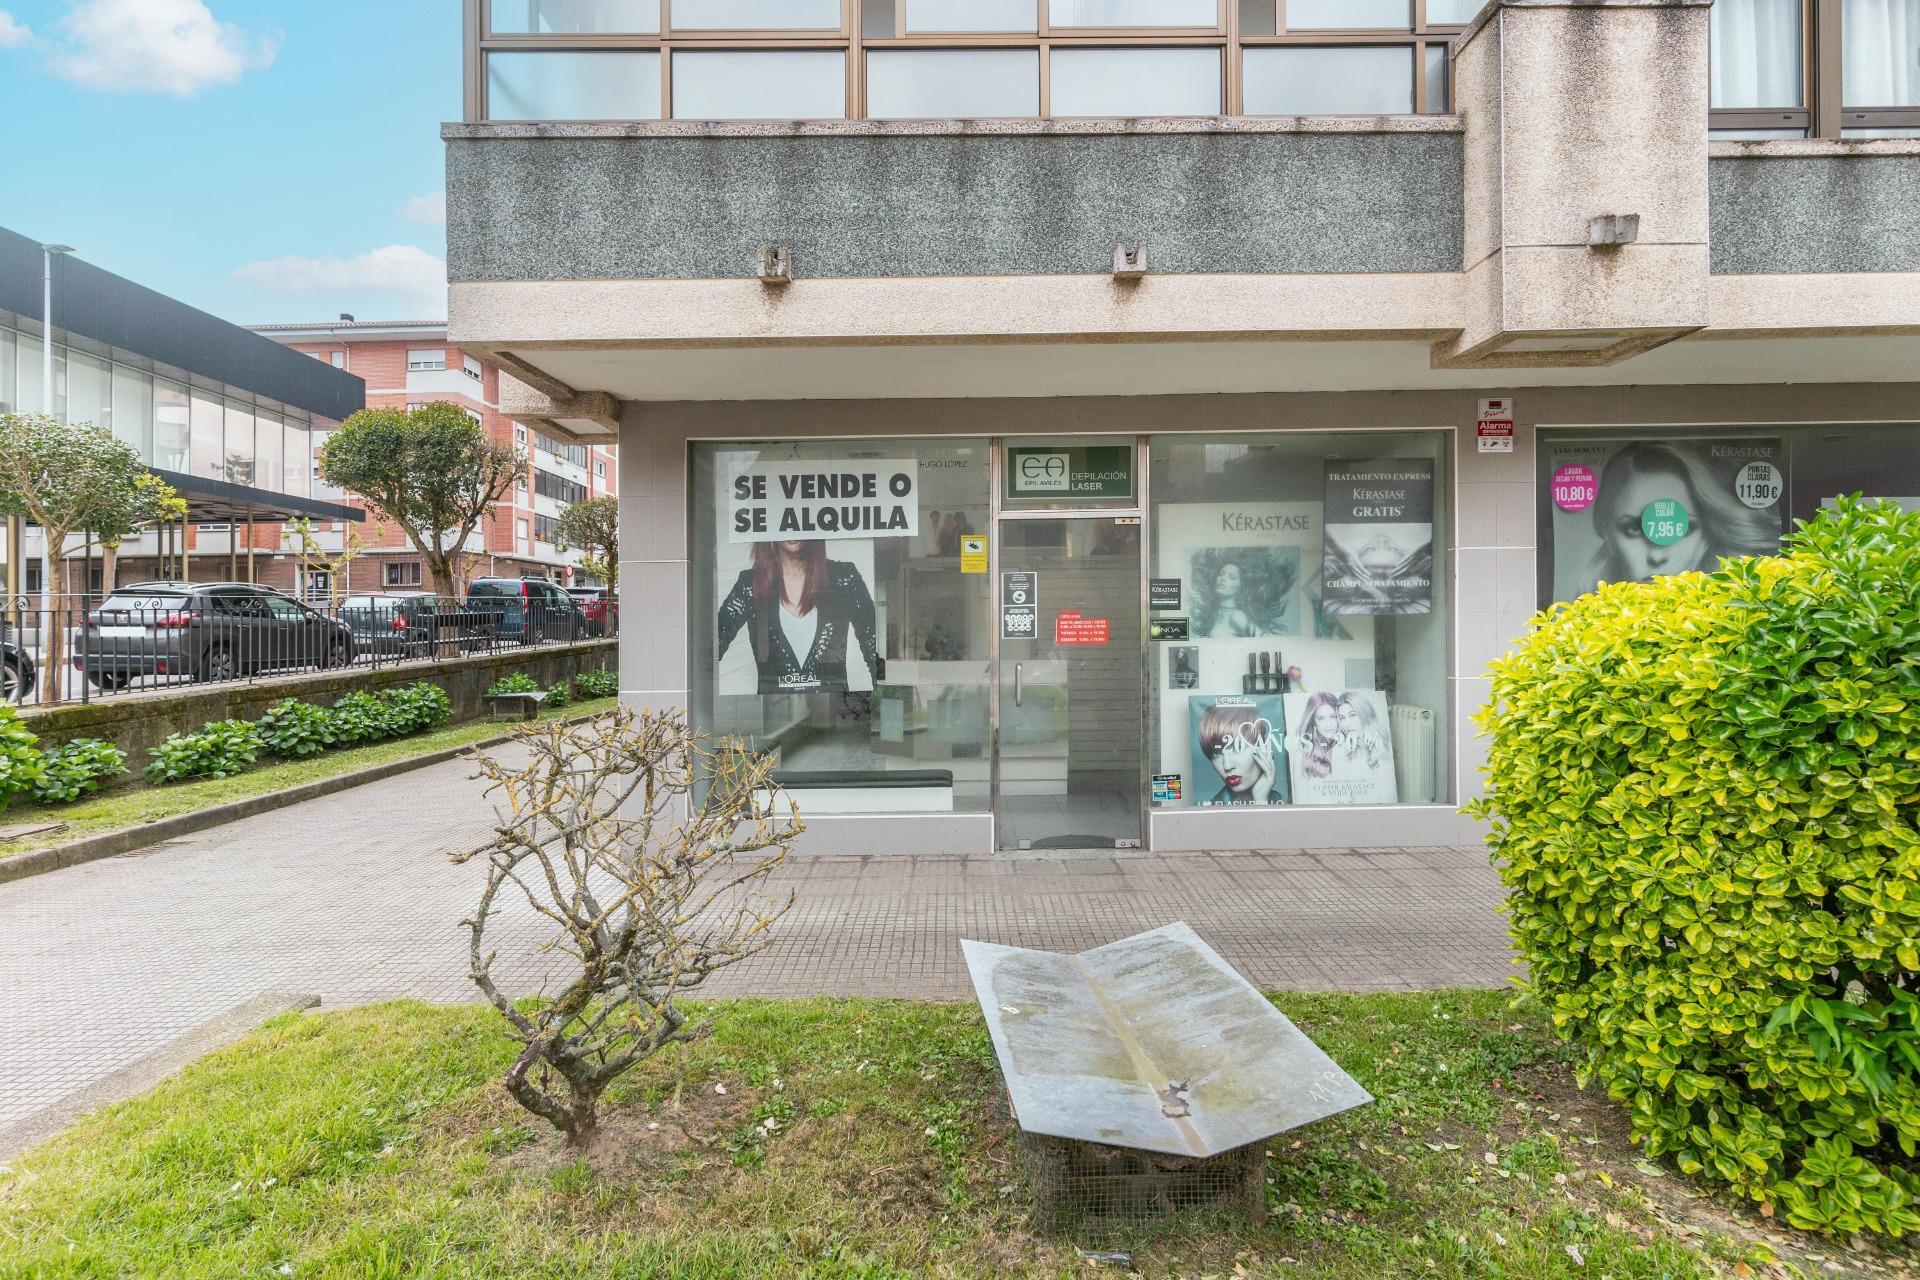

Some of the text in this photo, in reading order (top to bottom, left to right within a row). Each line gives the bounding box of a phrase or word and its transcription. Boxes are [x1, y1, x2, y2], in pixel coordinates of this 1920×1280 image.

[1480, 421, 1511, 430] Alarma
[1747, 465, 1771, 473] PUNTAS
[1071, 470, 1127, 481] DEPILACIÓN
[1393, 472, 1431, 480] EXPRESS
[735, 473, 911, 500] SE VENDE O
[1071, 482, 1103, 491] LASER
[1739, 484, 1778, 499] 11,90 €
[1353, 488, 1406, 500] KÉRASTASE
[1555, 486, 1594, 502] 10,80 €
[1654, 501, 1675, 510] BRILLO
[735, 505, 909, 532] SE ALQUILA
[1222, 512, 1310, 531] KÉRASTASE
[1647, 521, 1684, 539] 7,95 €
